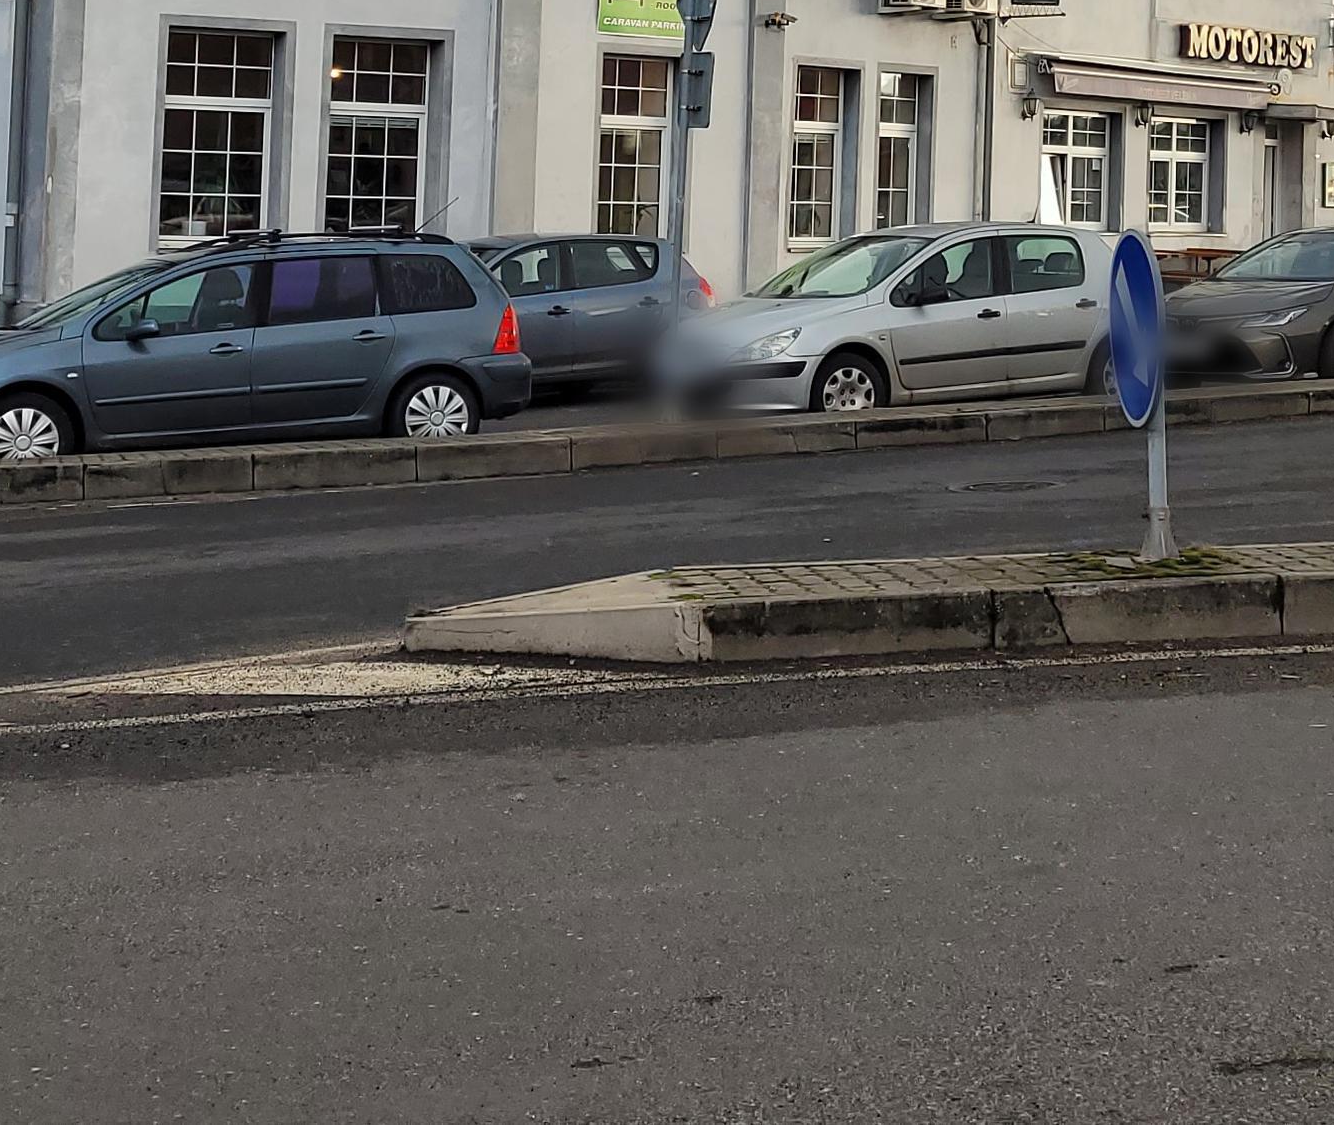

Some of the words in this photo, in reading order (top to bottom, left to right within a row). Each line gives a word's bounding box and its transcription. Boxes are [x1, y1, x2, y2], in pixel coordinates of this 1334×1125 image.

[656, 1, 676, 10] ROO
[603, 17, 649, 28] CARAVAN
[1188, 24, 1316, 69] MOTOREST
